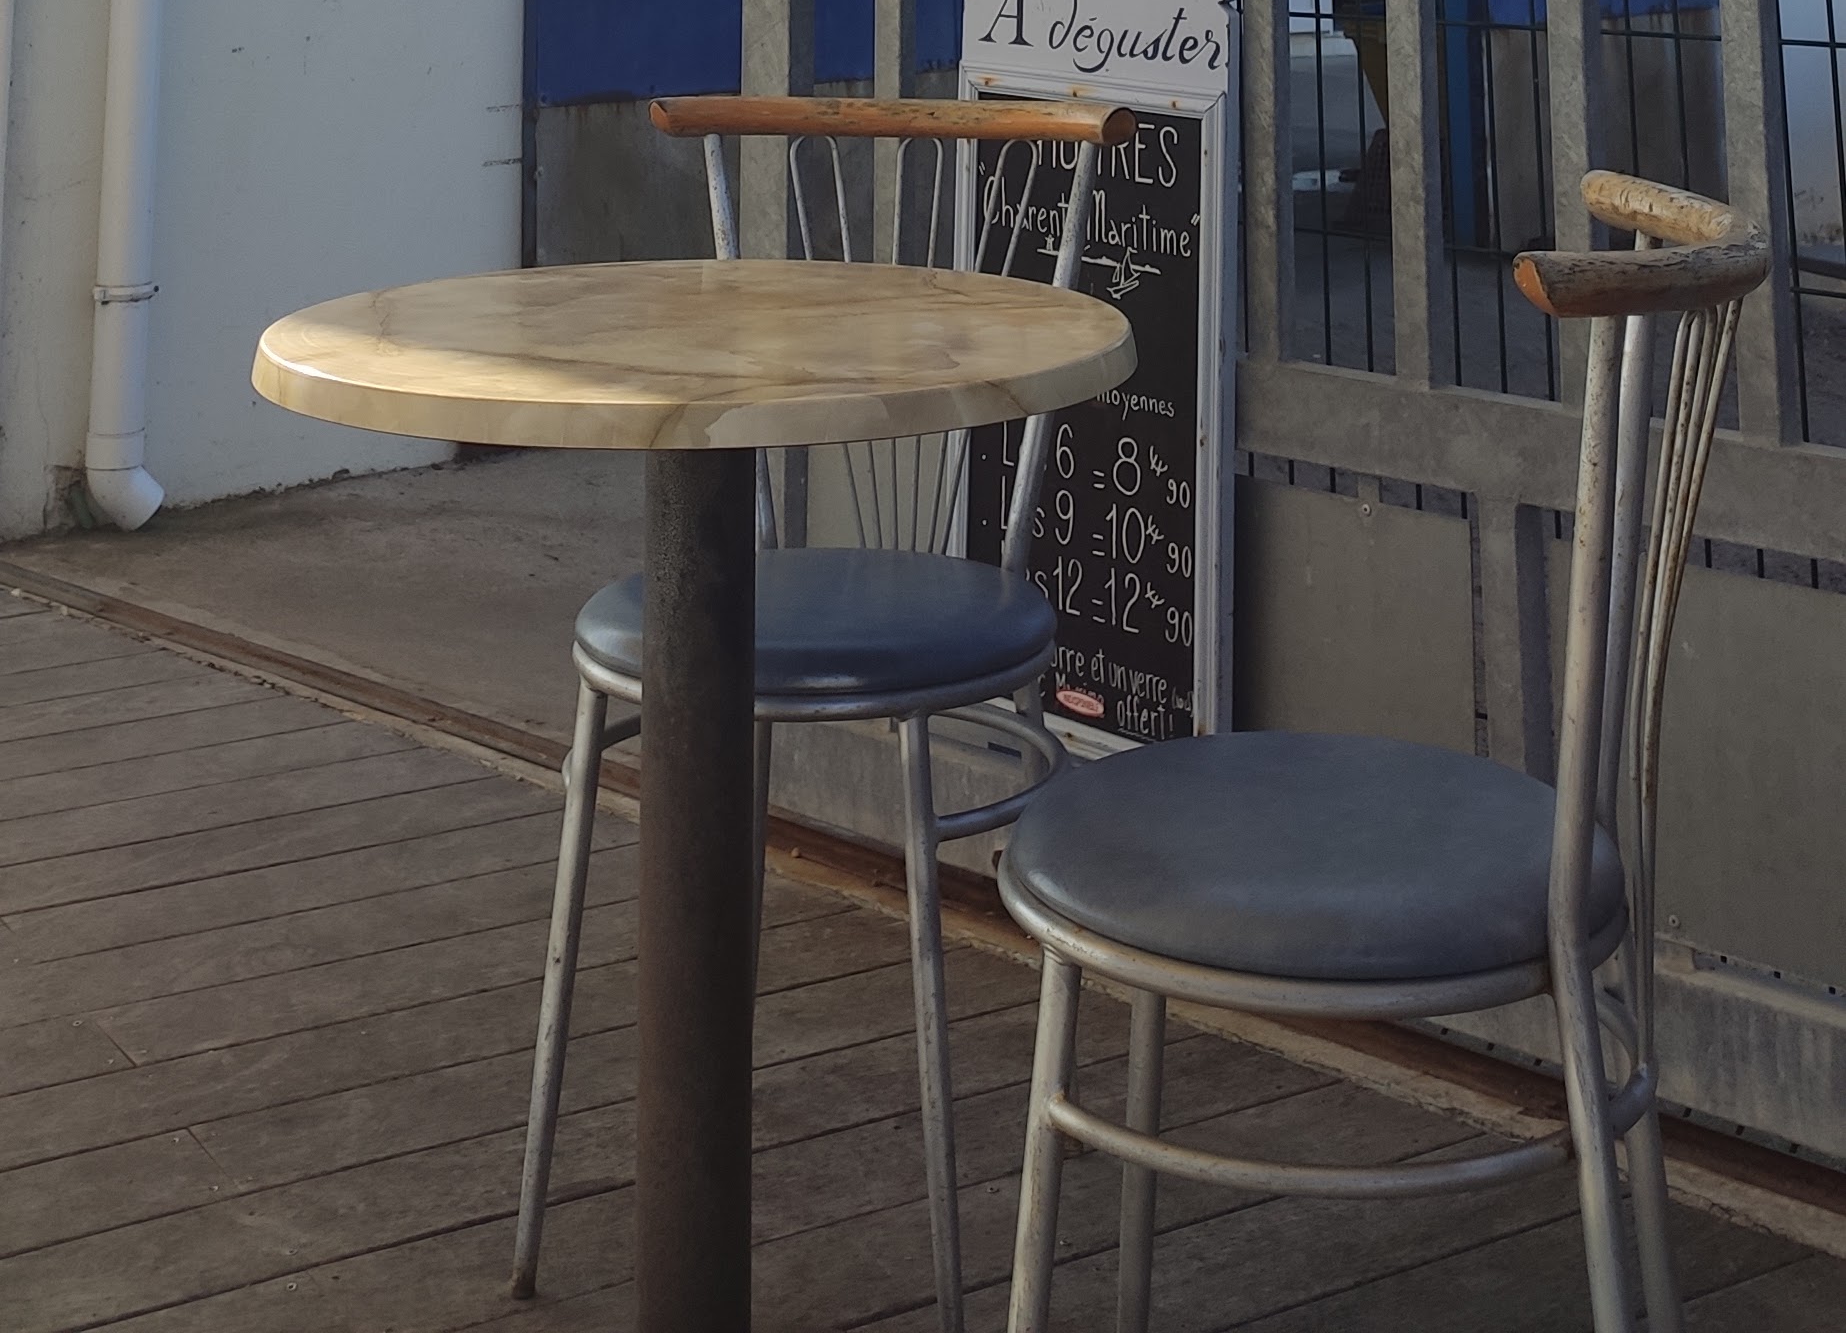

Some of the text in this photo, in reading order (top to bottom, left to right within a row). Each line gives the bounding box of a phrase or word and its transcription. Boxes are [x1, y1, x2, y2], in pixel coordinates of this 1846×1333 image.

[1056, 423, 1075, 480] 6
[1055, 490, 1075, 546] 9
[1052, 555, 1082, 617] 12
[1090, 648, 1105, 684] et
[1108, 661, 1128, 692] un
[1129, 669, 1168, 704] verre
